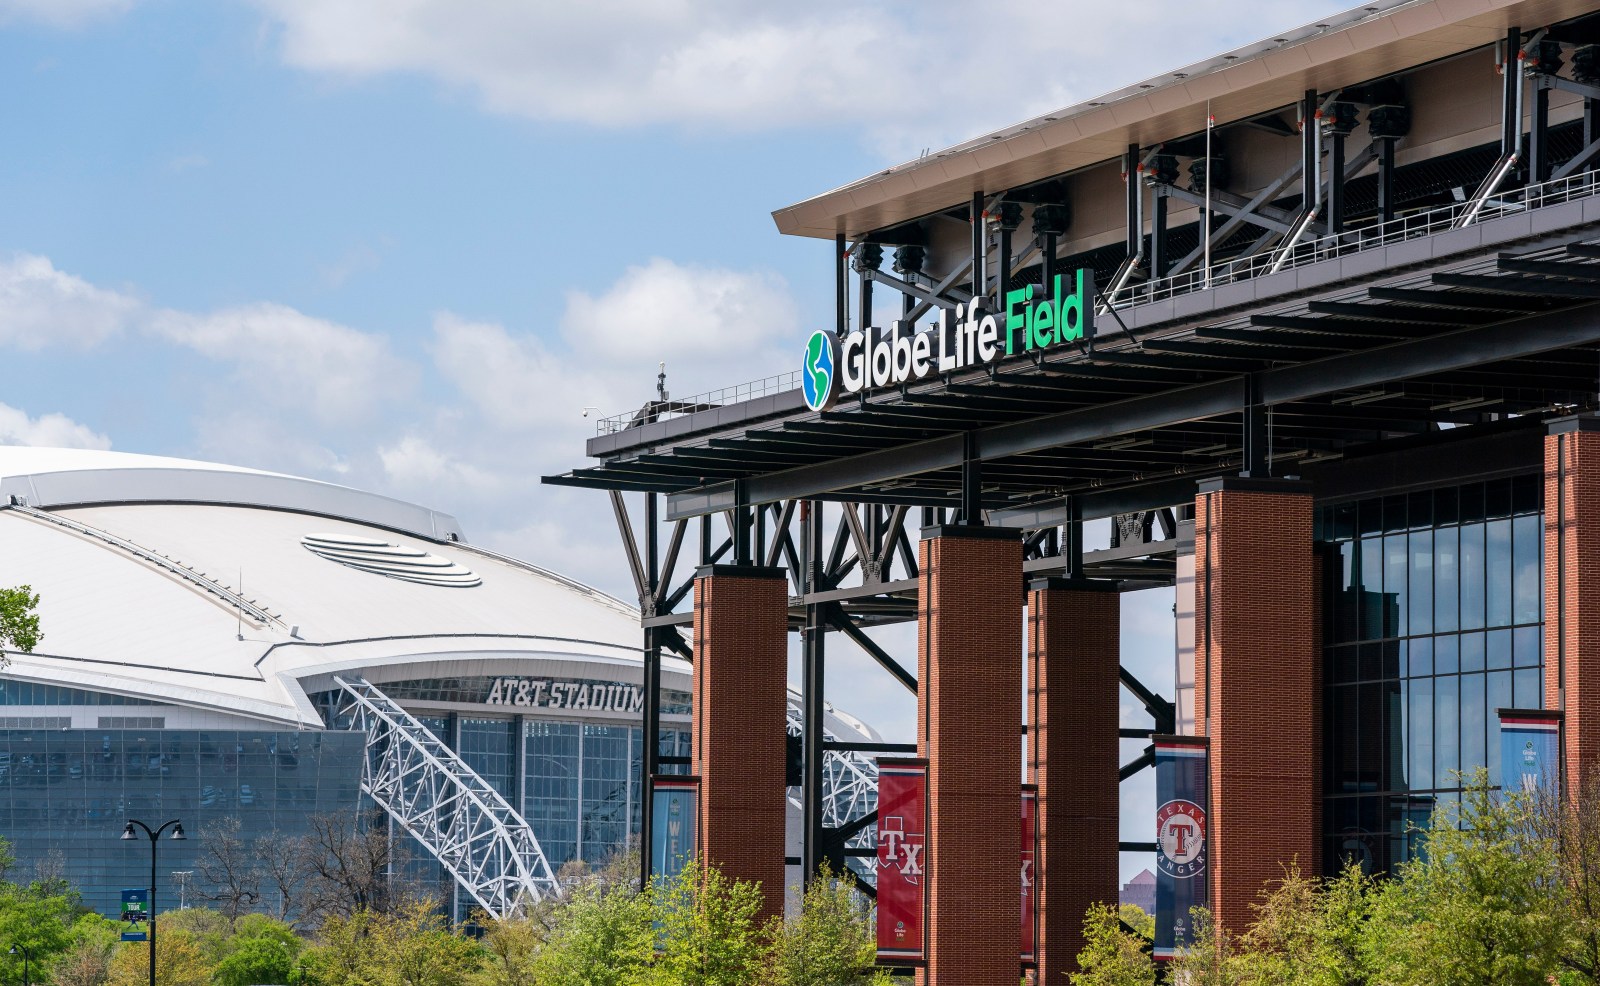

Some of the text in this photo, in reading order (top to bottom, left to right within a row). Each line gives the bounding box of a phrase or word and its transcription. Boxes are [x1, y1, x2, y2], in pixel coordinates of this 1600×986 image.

[842, 268, 1084, 393] Globe Life Field
[486, 678, 645, 713] AT&T STADIUM
[1157, 804, 1205, 824] TEXAS
[1169, 823, 1194, 856] T
